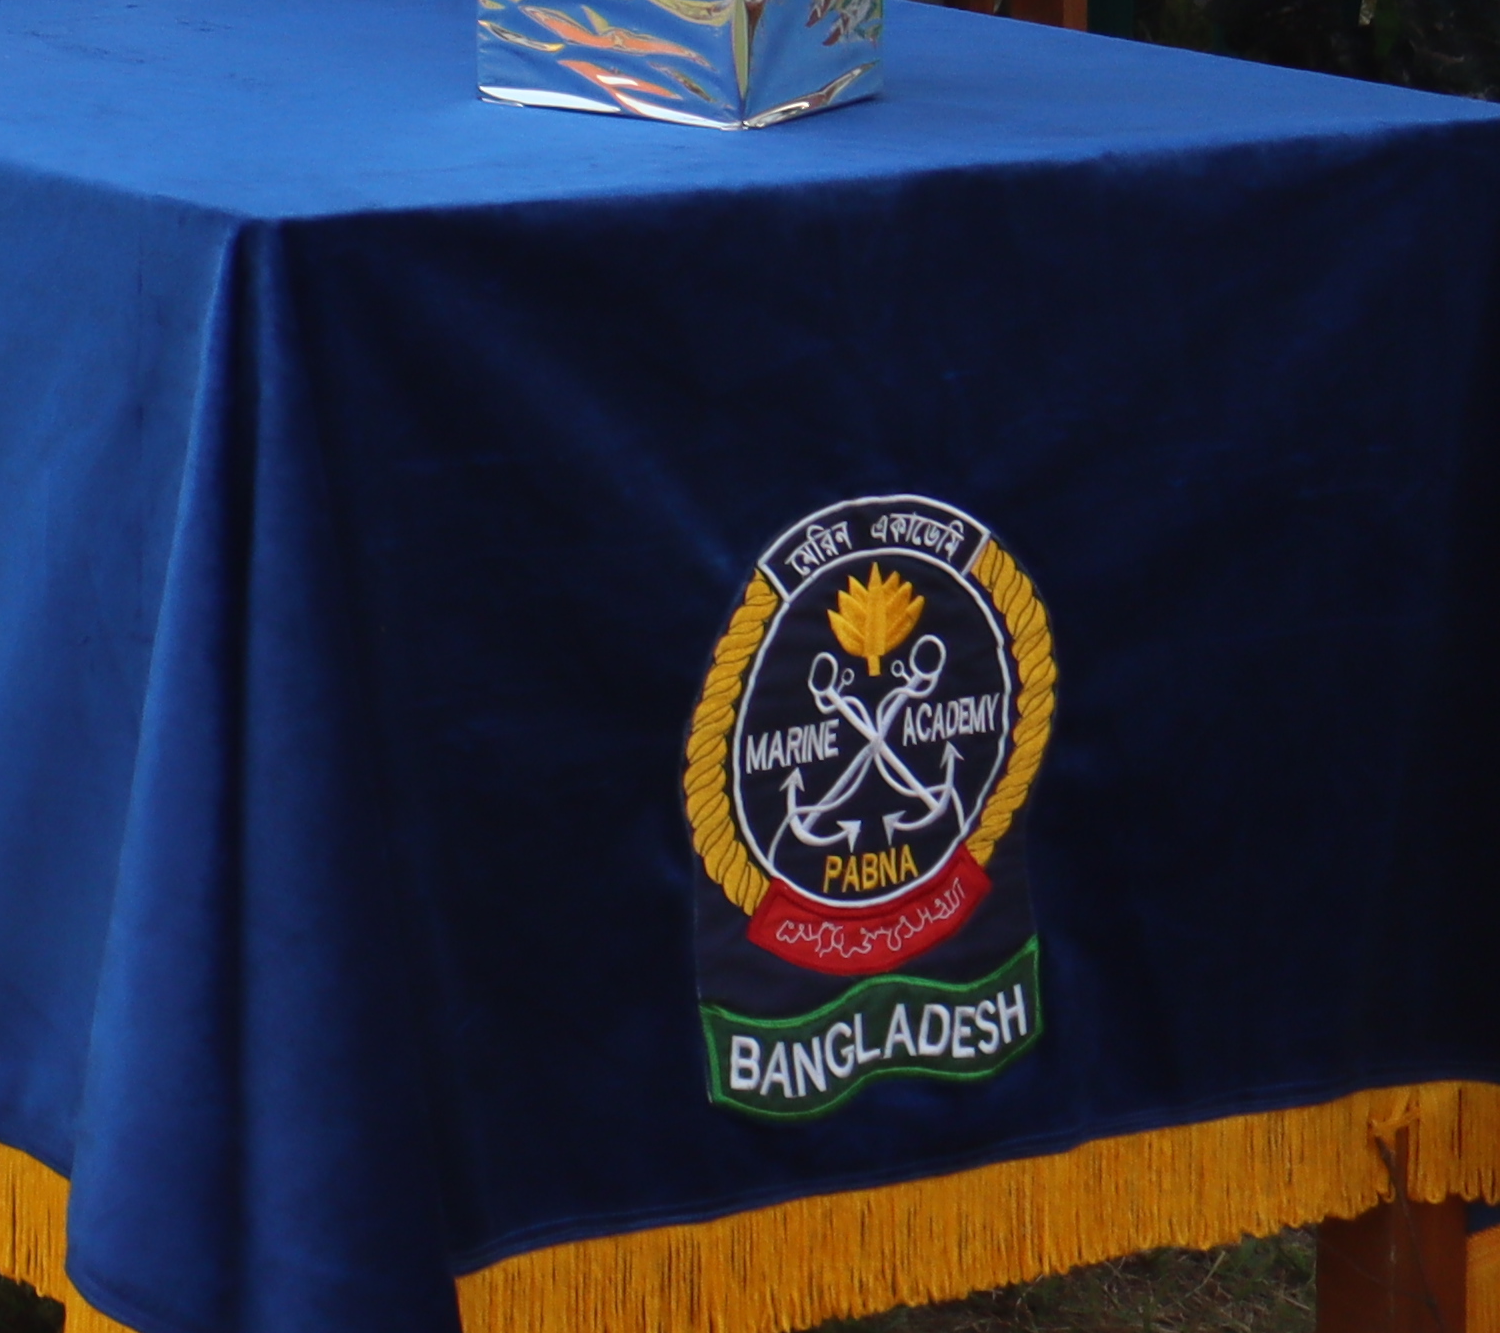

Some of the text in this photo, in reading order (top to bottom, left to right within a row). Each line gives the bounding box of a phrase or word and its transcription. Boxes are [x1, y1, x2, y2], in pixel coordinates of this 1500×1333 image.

[784, 521, 852, 577] মেরিন
[744, 691, 1000, 774] MARINE ACADEMY
[821, 842, 919, 894] PABNA
[729, 983, 1029, 1101] BANGLADESH
